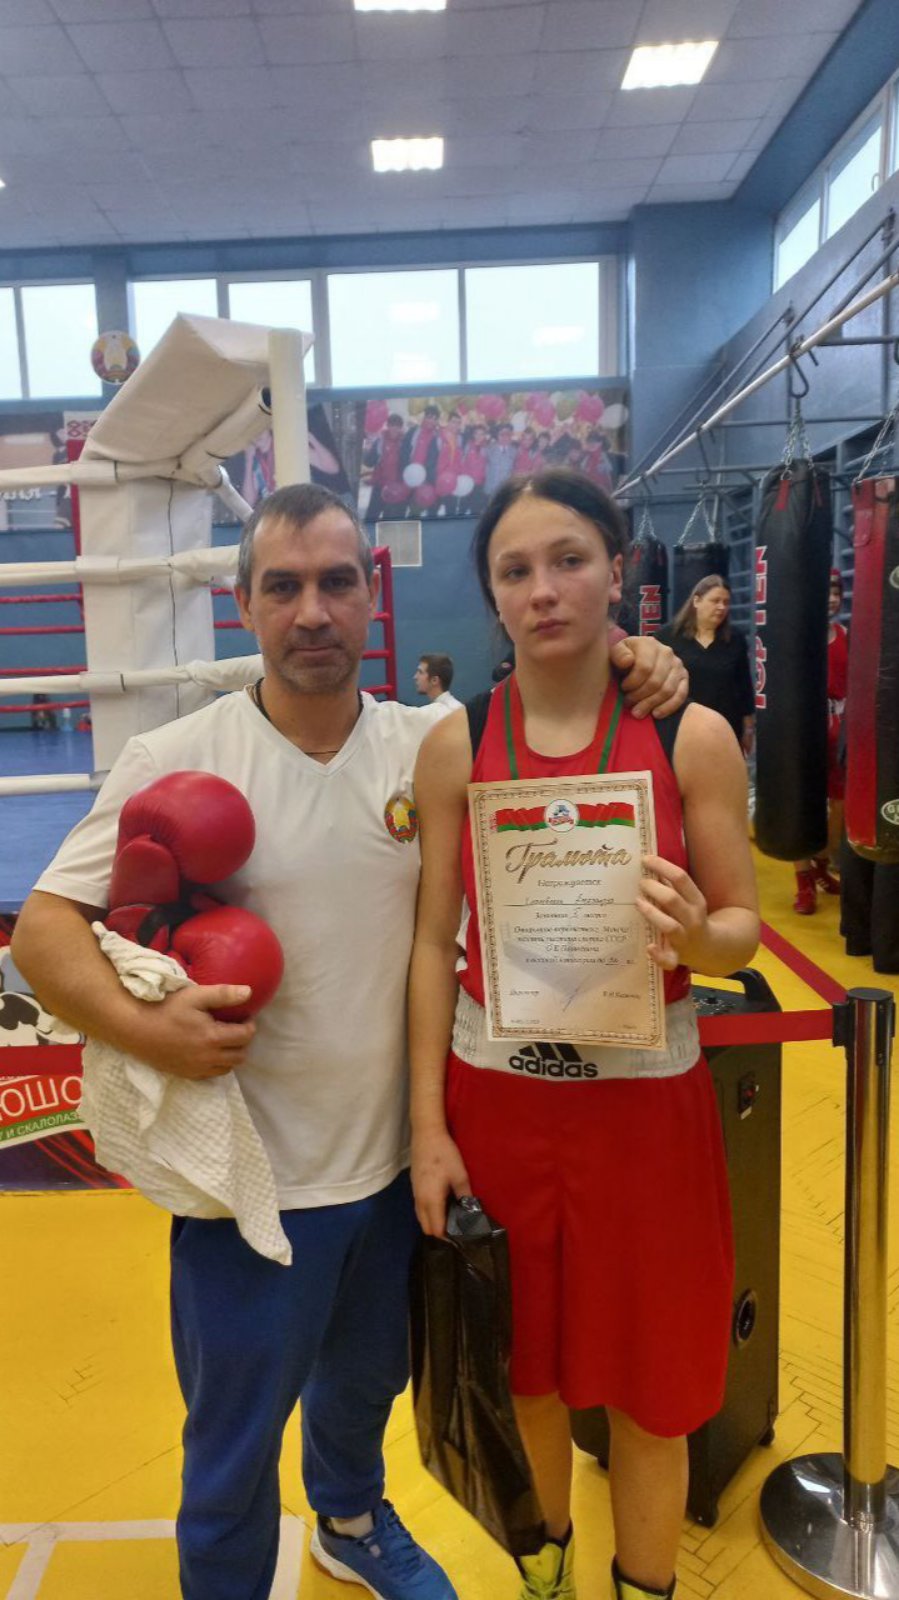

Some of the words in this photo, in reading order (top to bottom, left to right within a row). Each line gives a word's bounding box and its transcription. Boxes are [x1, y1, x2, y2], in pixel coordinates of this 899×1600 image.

[505, 838, 632, 884] Грамота
[509, 1055, 599, 1078] adidas
[17, 1111, 82, 1135] СКАЛОЛАЗ
